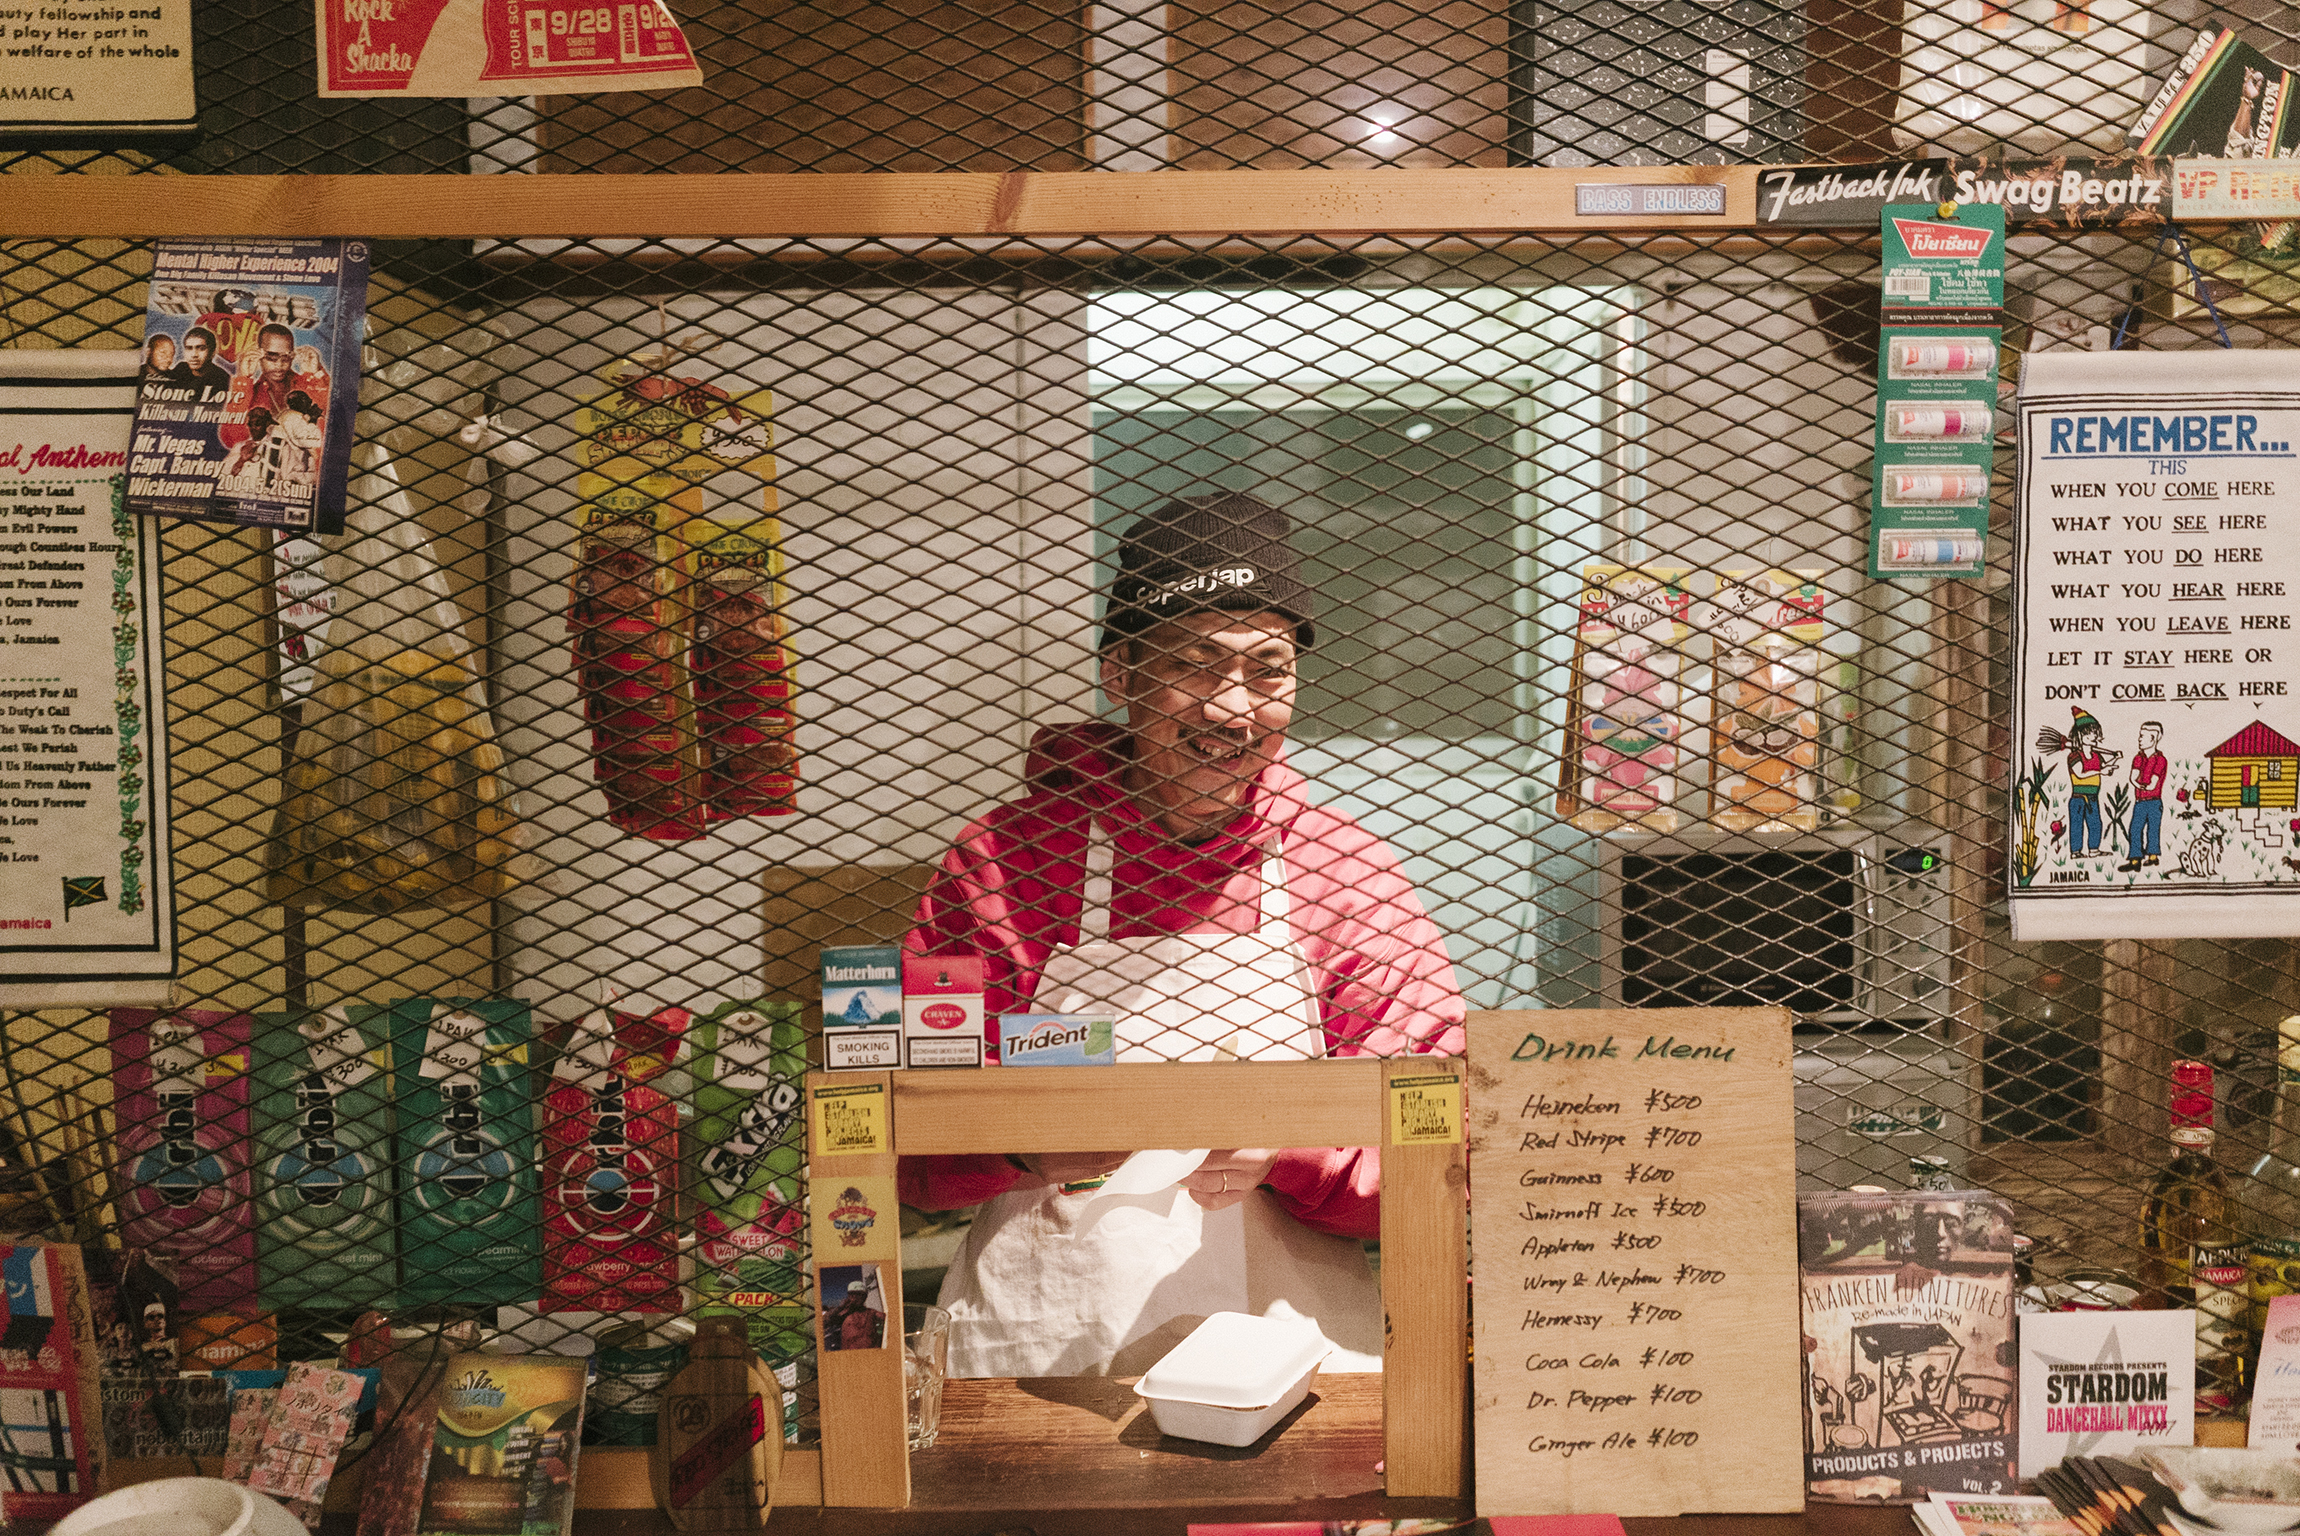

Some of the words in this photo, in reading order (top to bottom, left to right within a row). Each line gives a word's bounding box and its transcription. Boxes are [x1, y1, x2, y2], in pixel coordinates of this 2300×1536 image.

[40, 6, 125, 22] fellowship
[129, 6, 161, 20] and
[550, 7, 613, 35] 9/28
[13, 25, 51, 41] play
[57, 27, 87, 40] Her
[94, 27, 127, 42] part
[133, 25, 148, 38] in
[357, 24, 372, 48] A
[7, 44, 73, 58] welfare
[77, 45, 94, 59] of
[100, 44, 124, 58] the
[127, 44, 180, 58] whole
[344, 43, 414, 74] Shacka
[509, 29, 522, 70] TOUR
[2178, 29, 2217, 75] 350
[1764, 170, 1887, 222] Fastback
[1884, 162, 1933, 203] Ink
[2178, 171, 2218, 200] VP
[1581, 188, 1631, 212] BASS
[1643, 187, 1722, 212] ENDLESS
[156, 251, 200, 269] Mental
[199, 253, 241, 272] Higher
[240, 256, 307, 273] Experience
[307, 256, 339, 274] 2004
[140, 383, 195, 402] Stone
[199, 385, 245, 405] Love
[138, 403, 190, 423] Killasan
[191, 405, 249, 426] Movement
[2050, 414, 2289, 454] REMEMBER...
[131, 434, 156, 453] Mr.
[158, 435, 206, 456] Vegas
[18, 443, 127, 475] Anthem
[129, 454, 168, 475] Capt.
[169, 455, 224, 479] Barkey
[2148, 459, 2187, 476] THIS
[21, 486, 46, 497] Our
[48, 486, 74, 497] Land
[127, 476, 214, 499] Wickerman
[2051, 483, 2106, 498] WHEN
[2116, 482, 2156, 497] YOU
[2165, 481, 2218, 497] COME
[2227, 481, 2275, 496] HERE
[13, 505, 52, 517] Mighty
[55, 505, 85, 515] Hand
[12, 523, 34, 534] Evil
[37, 523, 78, 534] Powers
[2051, 516, 2111, 531] WHAT
[2123, 516, 2162, 531] YOU
[2173, 515, 2206, 530] SEE
[2219, 515, 2267, 529] HERE
[30, 541, 85, 553] Countless
[28, 560, 85, 571] Defenders
[2052, 550, 2111, 565] WHAT
[2124, 549, 2163, 564] YOU
[2175, 549, 2202, 564] DO
[2214, 548, 2263, 563] HERE
[17, 579, 47, 590] From
[50, 579, 84, 590] Above
[2051, 584, 2110, 598] WHAT
[2121, 583, 2161, 598] YOU
[2173, 583, 2223, 597] HEAR
[2236, 582, 2286, 597] HERE
[6, 598, 33, 608] Ours
[36, 598, 79, 609] Forever
[6, 616, 32, 626] Love
[2049, 617, 2104, 632] WHEN
[2116, 617, 2156, 632] YOU
[2167, 616, 2229, 631] LEAVE
[2240, 615, 2291, 630] HERE
[13, 634, 60, 645] Jamaica
[2047, 651, 2082, 666] LET
[2094, 651, 2113, 665] IT
[2123, 650, 2174, 665] STAY
[2184, 649, 2233, 663] HERE
[2245, 648, 2272, 663] OR
[40, 688, 60, 699] For
[63, 688, 78, 698] All
[2045, 684, 2100, 700] DON'T
[2112, 683, 2165, 698] COME
[2176, 682, 2228, 697] BACK
[2239, 681, 2288, 696] HERE
[9, 705, 44, 718] Duty's
[48, 705, 70, 717] Call
[18, 724, 48, 735] Weak
[52, 724, 66, 735] To
[69, 724, 114, 735] Cherish
[22, 742, 38, 753] We
[6, 761, 20, 772] Us
[24, 761, 75, 773] Heavenly
[77, 761, 116, 772] Father
[24, 780, 54, 790] From
[58, 780, 91, 790] Above
[11, 798, 39, 808] Ours
[42, 798, 87, 809] Forever
[11, 816, 39, 827] Love
[12, 852, 39, 863] Love
[2049, 870, 2090, 883] JAMAICA
[825, 963, 896, 982] Matterhorn
[924, 1010, 962, 1019] CRAVEN
[837, 1041, 889, 1053] SMOKING
[1006, 1023, 1089, 1057] Trident
[1510, 1032, 1622, 1062] Drink
[1633, 1036, 1736, 1063] Menu
[848, 1054, 880, 1065] KILLS
[1644, 1088, 1702, 1114] ¥500
[1411, 1125, 1451, 1136] JAMAICA!
[1519, 1132, 1559, 1152] Red
[1566, 1129, 1626, 1154] Stripe
[1645, 1126, 1702, 1149] ¥700
[1519, 1168, 1602, 1187] Guinness
[1625, 1163, 1674, 1184] ¥600
[1519, 1201, 1602, 1221] Smirnoff
[1611, 1202, 1638, 1219] Ice
[1653, 1194, 1706, 1217] ¥500
[732, 1235, 767, 1246] SWEET
[1521, 1235, 1595, 1260] Appleton
[1611, 1230, 1661, 1250] ¥500
[1524, 1276, 1567, 1293] Wray
[1573, 1272, 1588, 1287] &
[1595, 1268, 1662, 1293] Nephew
[1674, 1263, 1726, 1285] ¥700
[1804, 1277, 1887, 1313] FRANKEN
[1895, 1277, 2014, 1320] FURNITURES
[1628, 1301, 1682, 1324] ¥700
[1912, 1304, 1922, 1317] in
[1924, 1306, 1962, 1326] JAPAN
[1525, 1353, 1569, 1371] Coca
[1579, 1352, 1620, 1370] Cola
[1639, 1346, 1694, 1368] ¥100
[2048, 1363, 2086, 1372] STARDOM
[2089, 1362, 2124, 1372] RECORDS
[2127, 1361, 2167, 1371] PRESENTS
[2047, 1371, 2168, 1404] STARDOM
[1527, 1391, 1558, 1410] Dr.
[1567, 1389, 1637, 1412] Pepper
[1650, 1384, 1703, 1406] ¥100
[2047, 1406, 2123, 1433] DANCEHALL
[2127, 1404, 2168, 1431] MIXXX
[1529, 1435, 1596, 1457] Ginger
[1602, 1431, 1637, 1450] Ale
[1647, 1428, 1699, 1448] ¥100
[1813, 1452, 1899, 1474] PRODUCTS
[1904, 1451, 1916, 1467] &
[1920, 1440, 2004, 1464] PROJECTS
[1962, 1478, 1988, 1493] VOL.
[1989, 1481, 2002, 1495] 2
